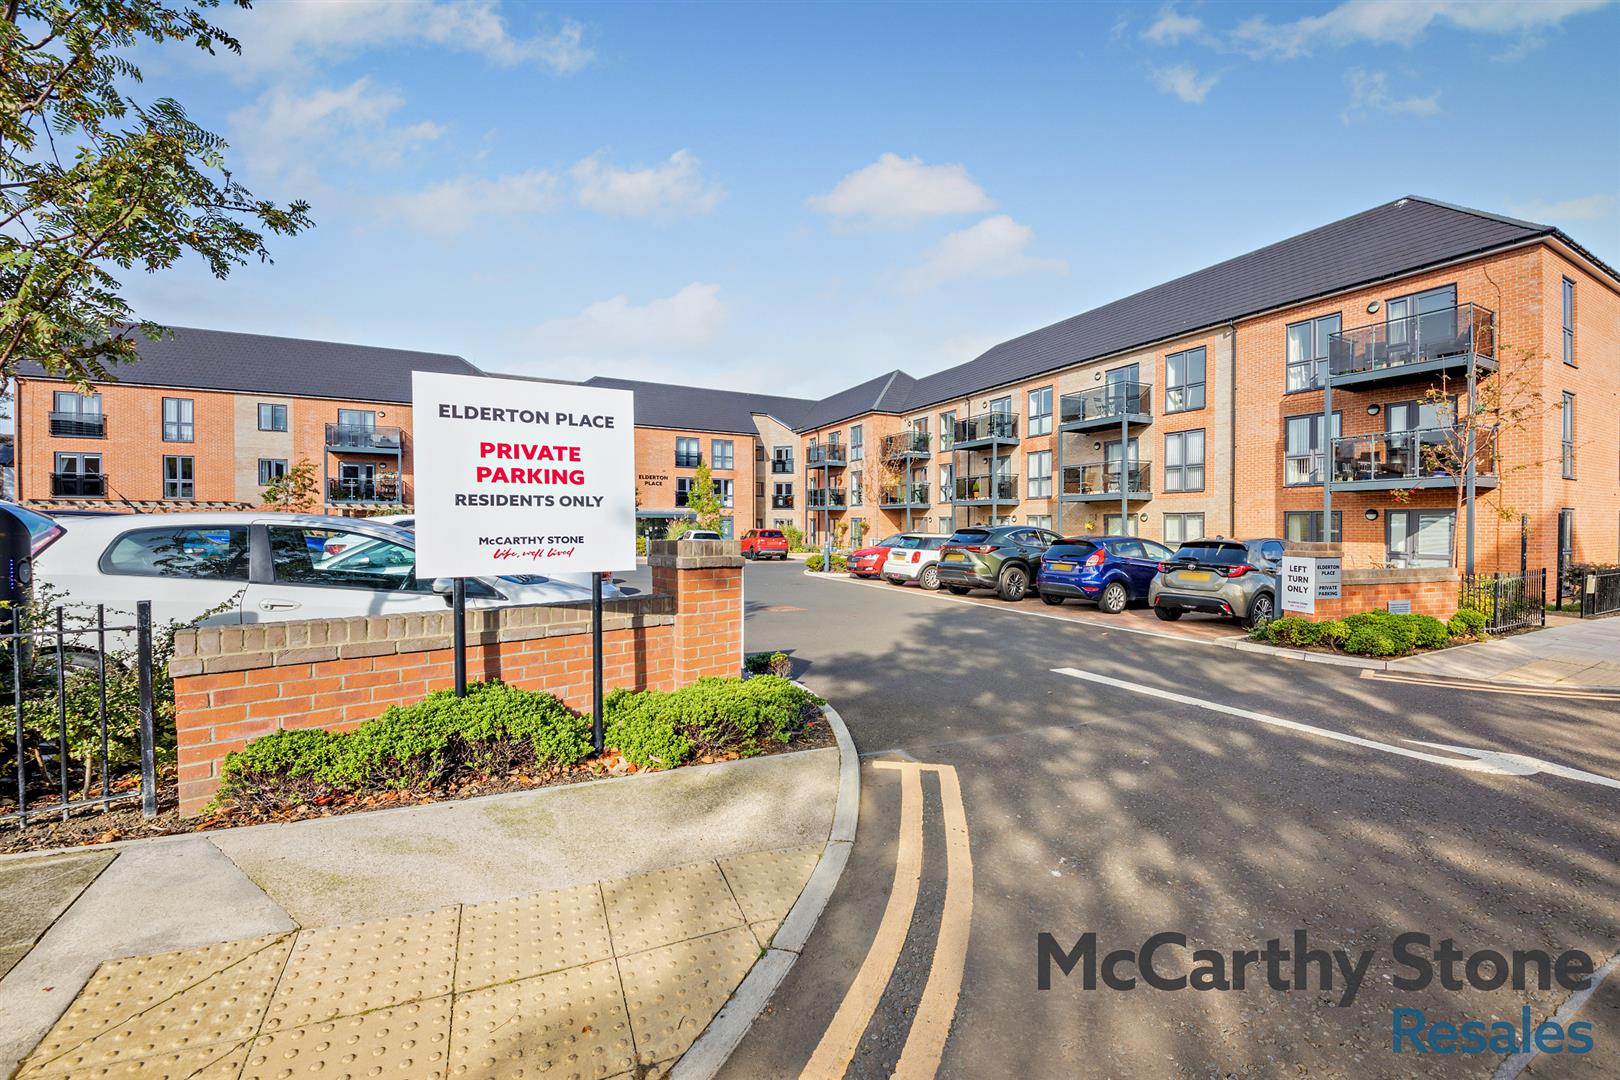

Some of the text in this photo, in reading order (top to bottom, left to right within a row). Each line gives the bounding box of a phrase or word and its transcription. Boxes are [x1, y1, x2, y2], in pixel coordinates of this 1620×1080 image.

[438, 404, 615, 429] ELDERTON PLACE
[480, 442, 581, 462] PRIVATE
[476, 467, 585, 485] PARKING
[455, 494, 604, 508] RESIDENTS ONLY
[479, 536, 585, 546] McCARTHY STONE
[1289, 564, 1308, 573] LEFT
[1287, 574, 1309, 584] TURN
[1287, 584, 1309, 594] ONLY
